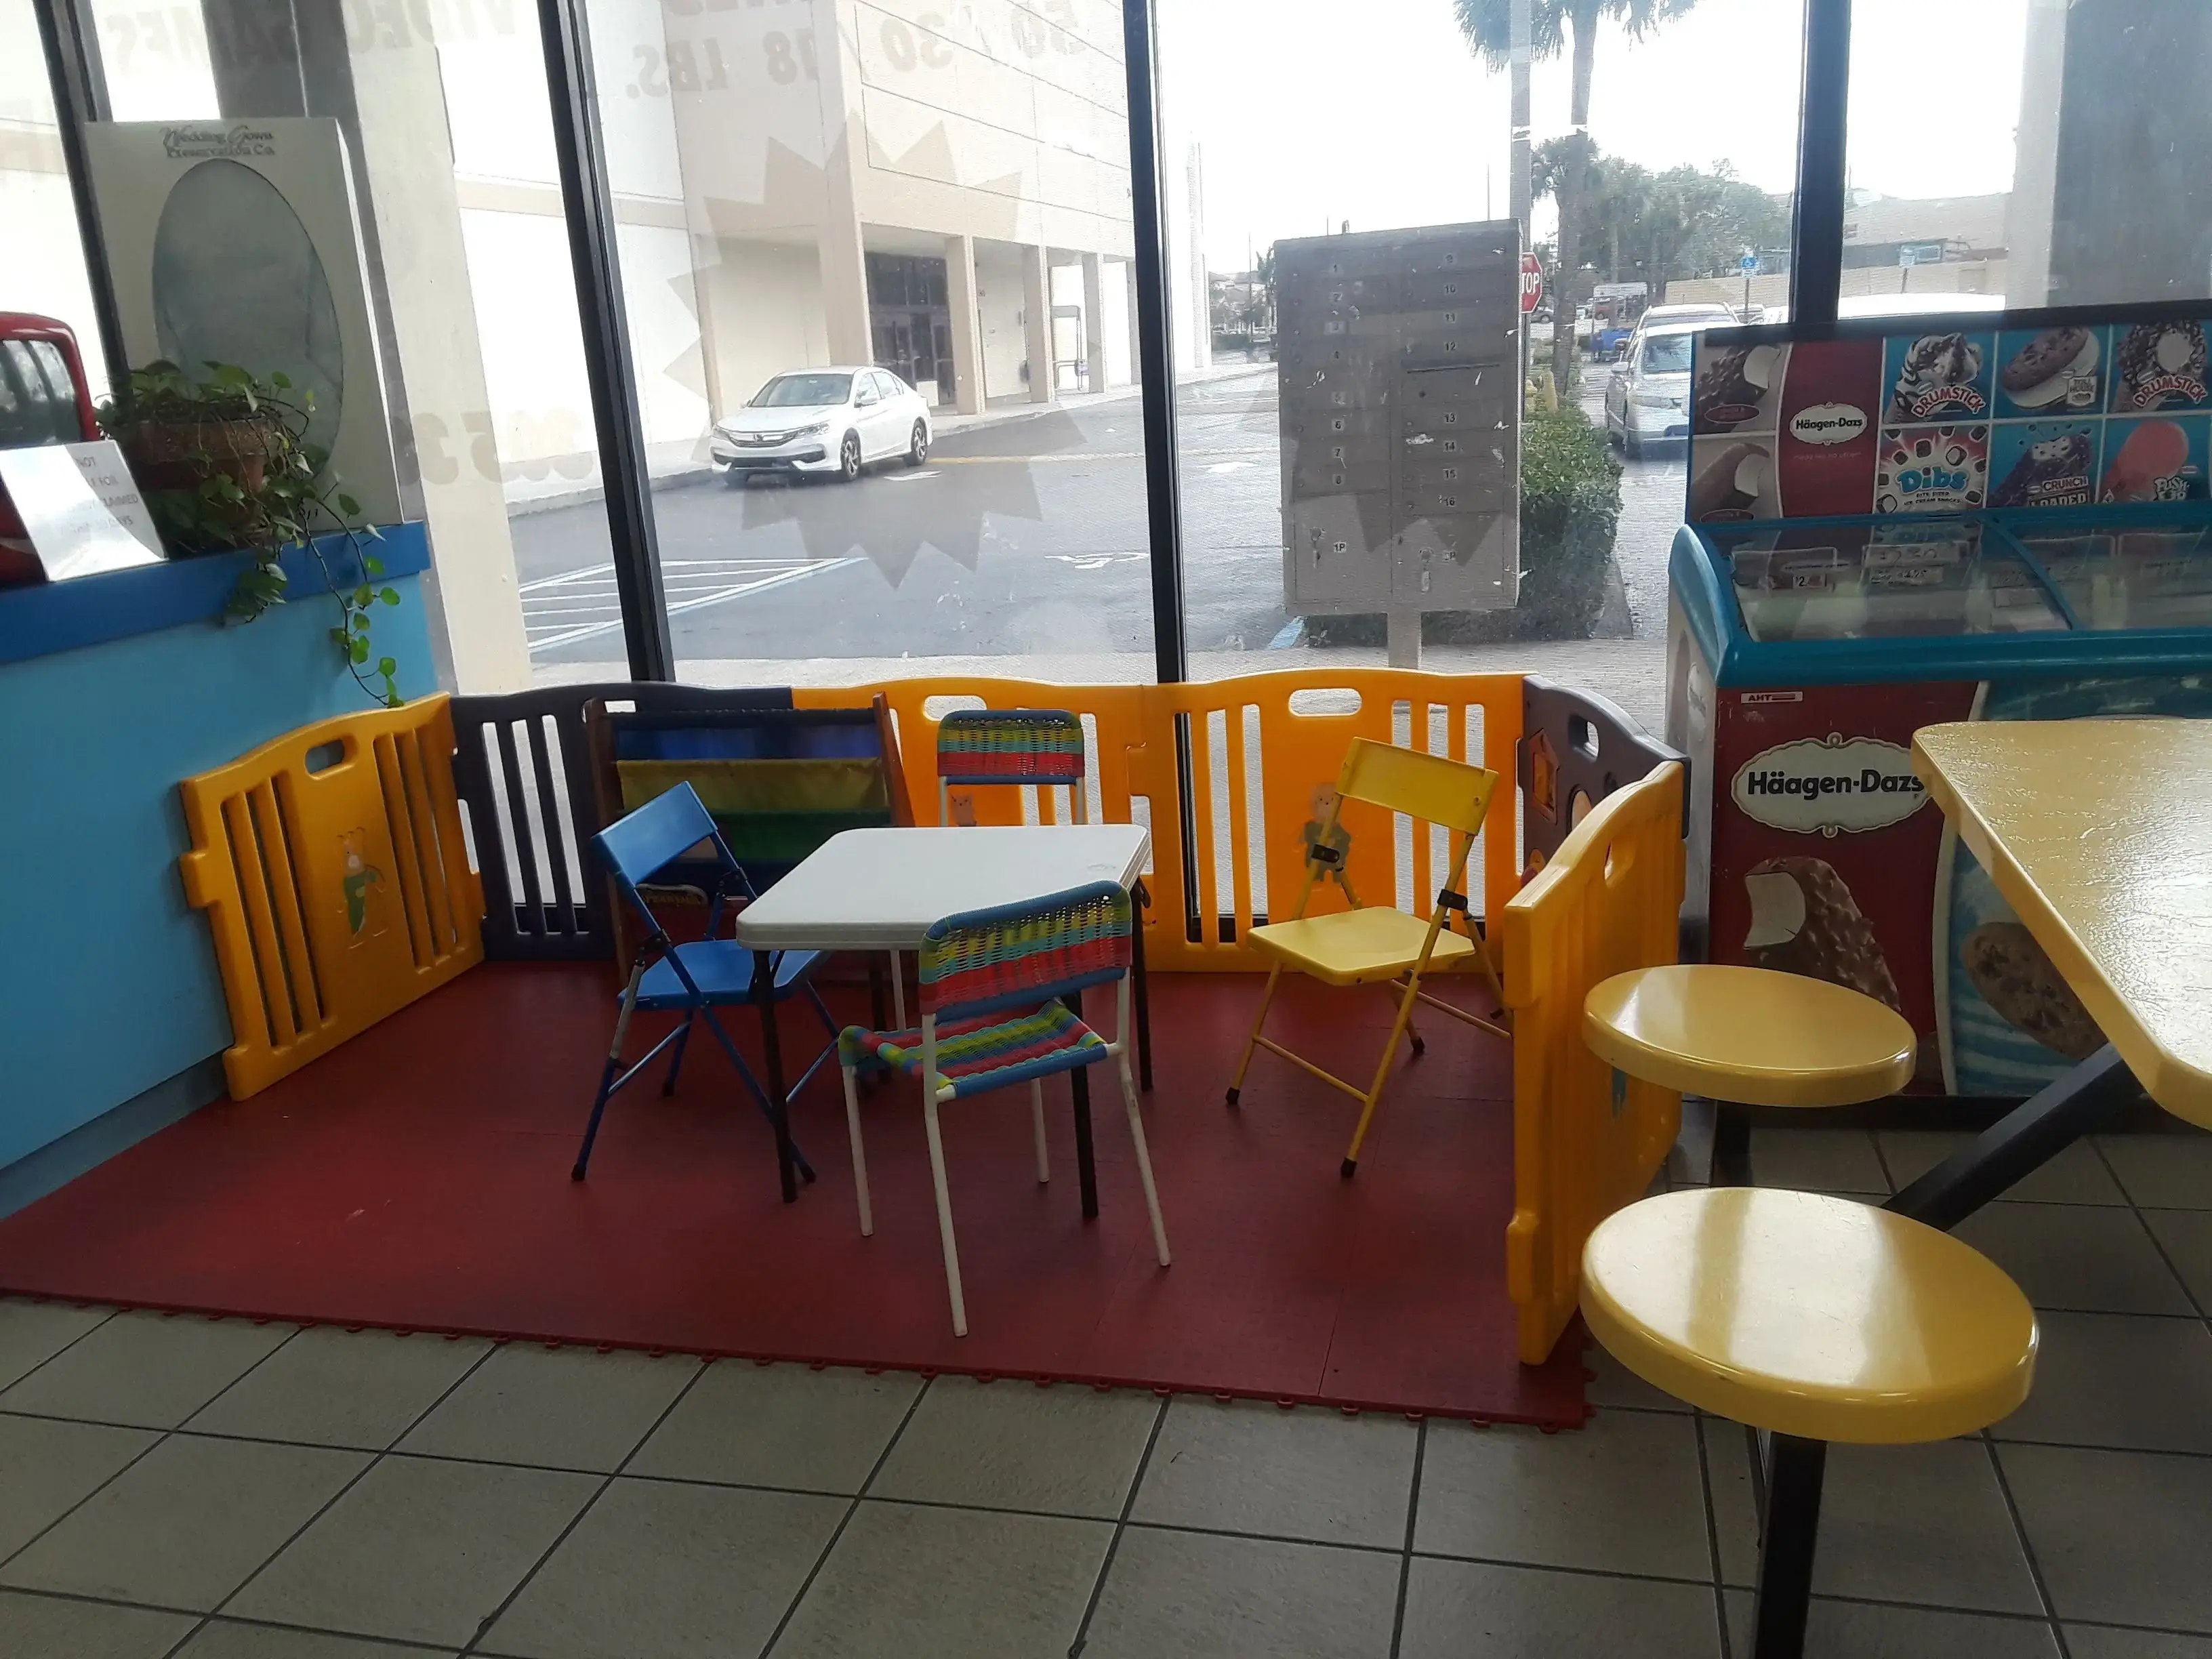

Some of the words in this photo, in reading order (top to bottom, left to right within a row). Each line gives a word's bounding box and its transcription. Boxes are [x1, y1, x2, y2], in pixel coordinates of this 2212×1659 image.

[1521, 272, 1540, 294] TOP
[1445, 341, 1456, 351] 12
[2133, 375, 2208, 407] DRUMSTICK
[1911, 386, 1986, 417] DRUMSTICK
[1795, 416, 1863, 431] Häagen-Dazs
[1897, 466, 1968, 493] Dibs
[2043, 476, 2087, 491] CRUNCH
[1334, 543, 1346, 552] 1P
[1748, 694, 1772, 702] AHT
[1747, 769, 1925, 801] Häagen-Dazs
